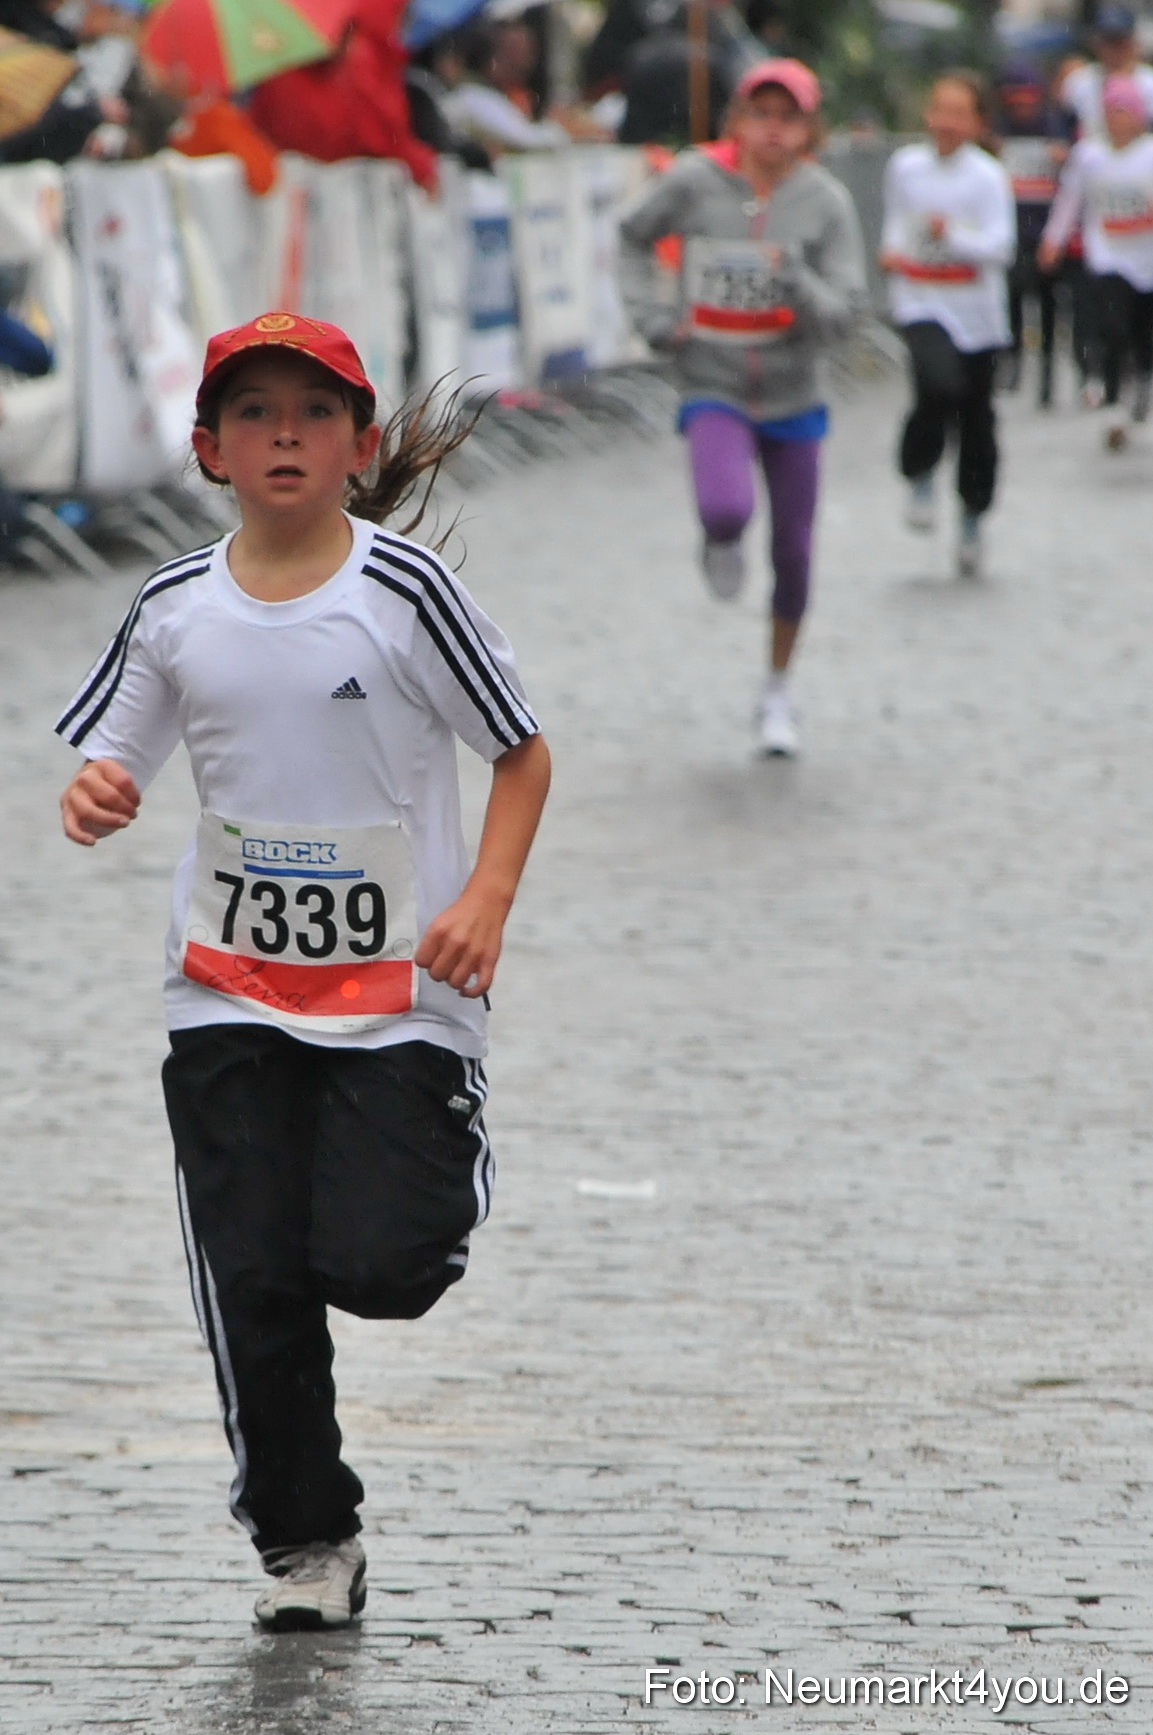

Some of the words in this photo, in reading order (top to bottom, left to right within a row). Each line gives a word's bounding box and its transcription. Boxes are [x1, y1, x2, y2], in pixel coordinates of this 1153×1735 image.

[331, 691, 367, 700] adidas
[242, 838, 337, 864] BOCK
[214, 870, 387, 958] 7339
